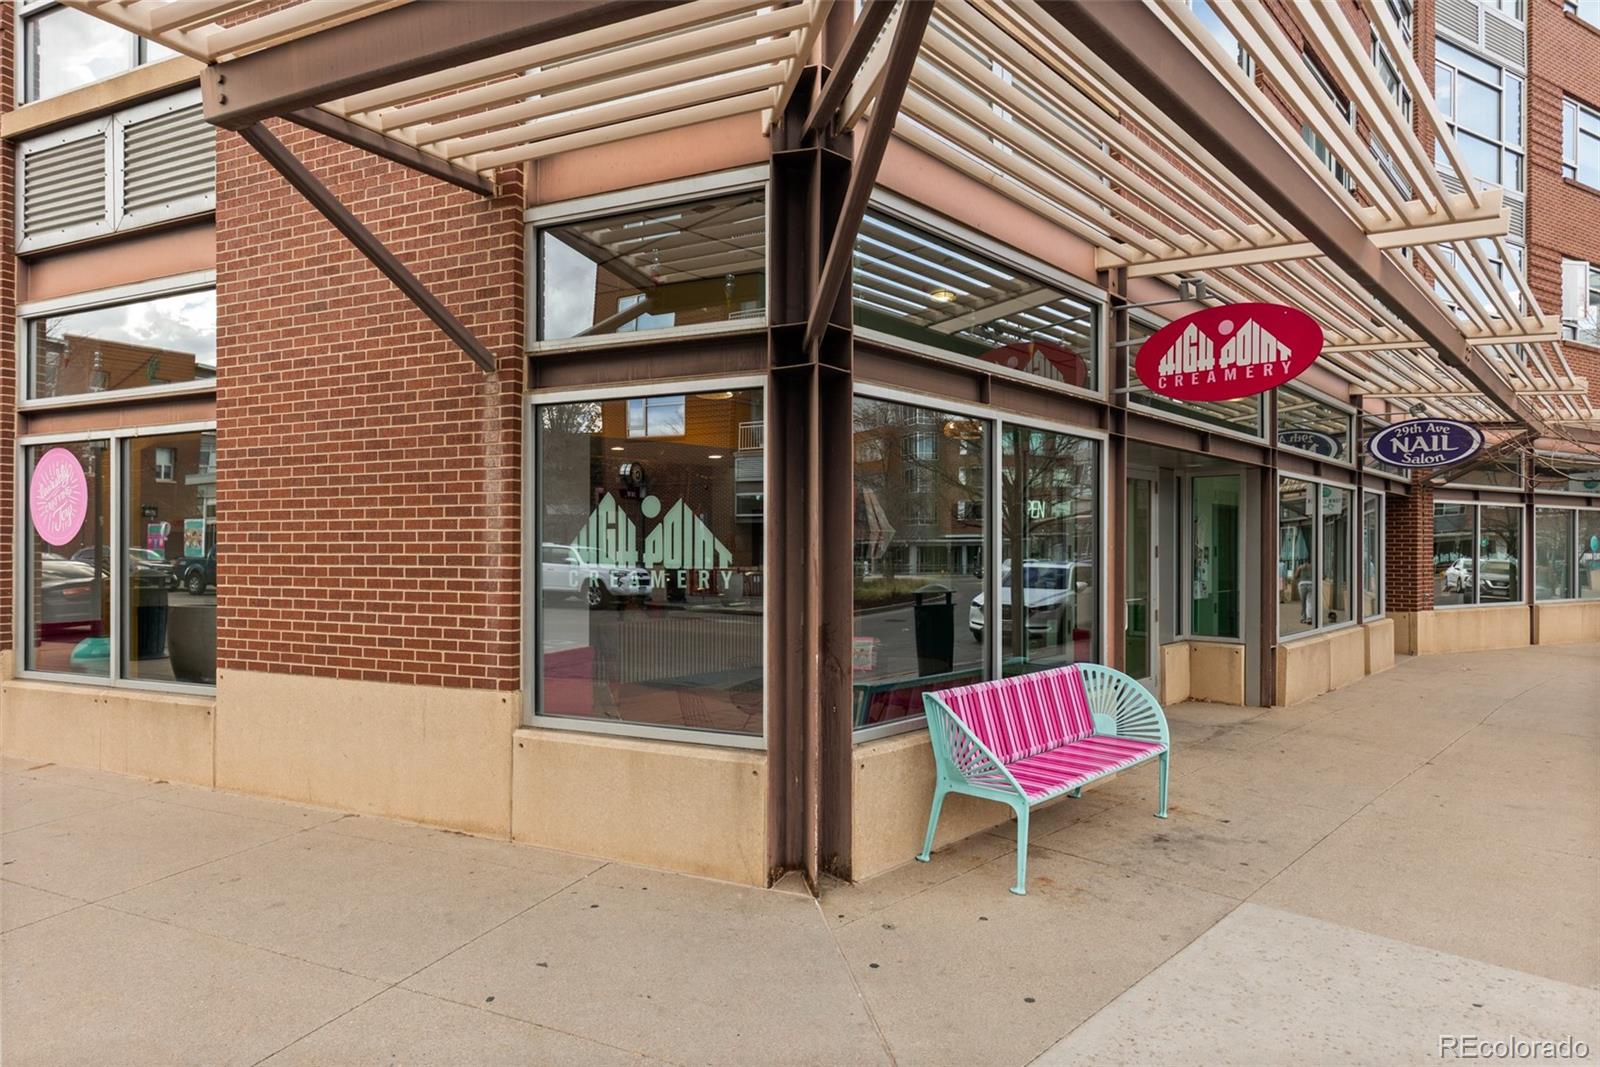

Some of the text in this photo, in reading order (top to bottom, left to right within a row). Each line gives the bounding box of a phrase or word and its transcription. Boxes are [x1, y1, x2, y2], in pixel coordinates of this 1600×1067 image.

[1158, 317, 1292, 376] HIGH POINT
[1158, 361, 1292, 389] CREAMERY
[1394, 422, 1451, 437] 29th Ave
[1389, 434, 1460, 454] NAIL
[1401, 452, 1446, 464] Salon
[643, 498, 733, 569] POINT
[568, 570, 734, 589] CREAMERY
